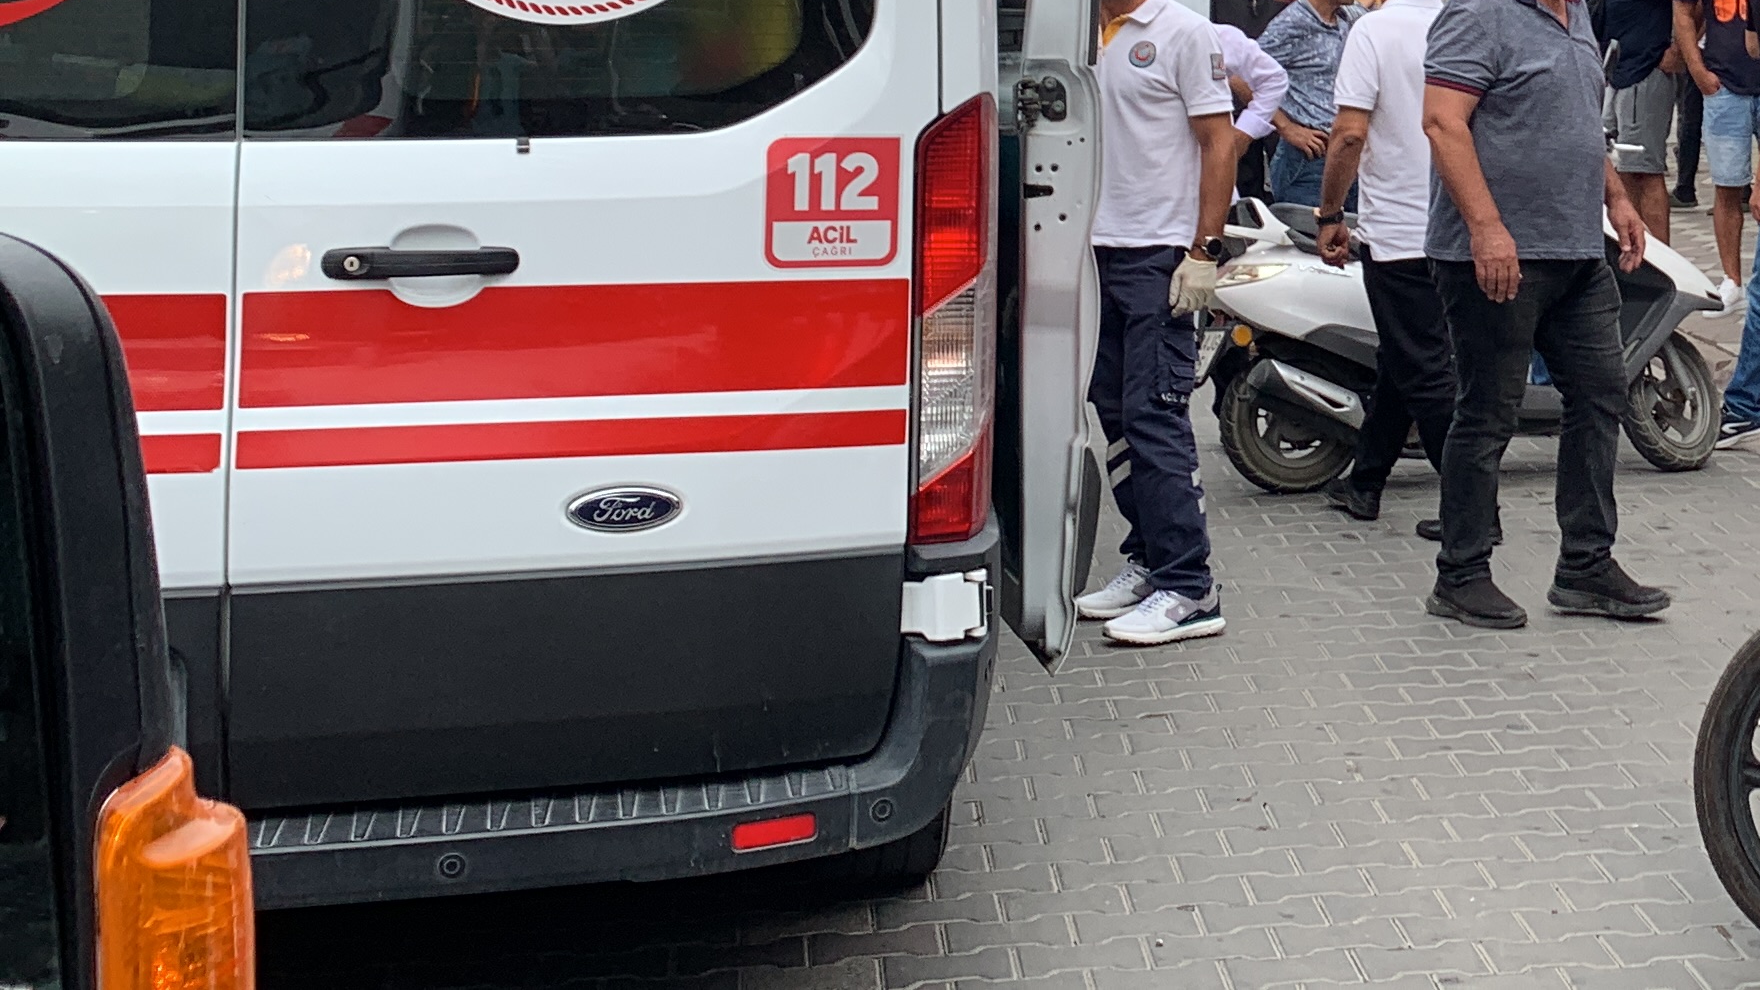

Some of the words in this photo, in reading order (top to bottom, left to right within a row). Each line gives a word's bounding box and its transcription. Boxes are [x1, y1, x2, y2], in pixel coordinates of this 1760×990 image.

[786, 151, 880, 212] 112
[812, 245, 853, 258] ÇAĞRI
[593, 496, 656, 523] Ford
